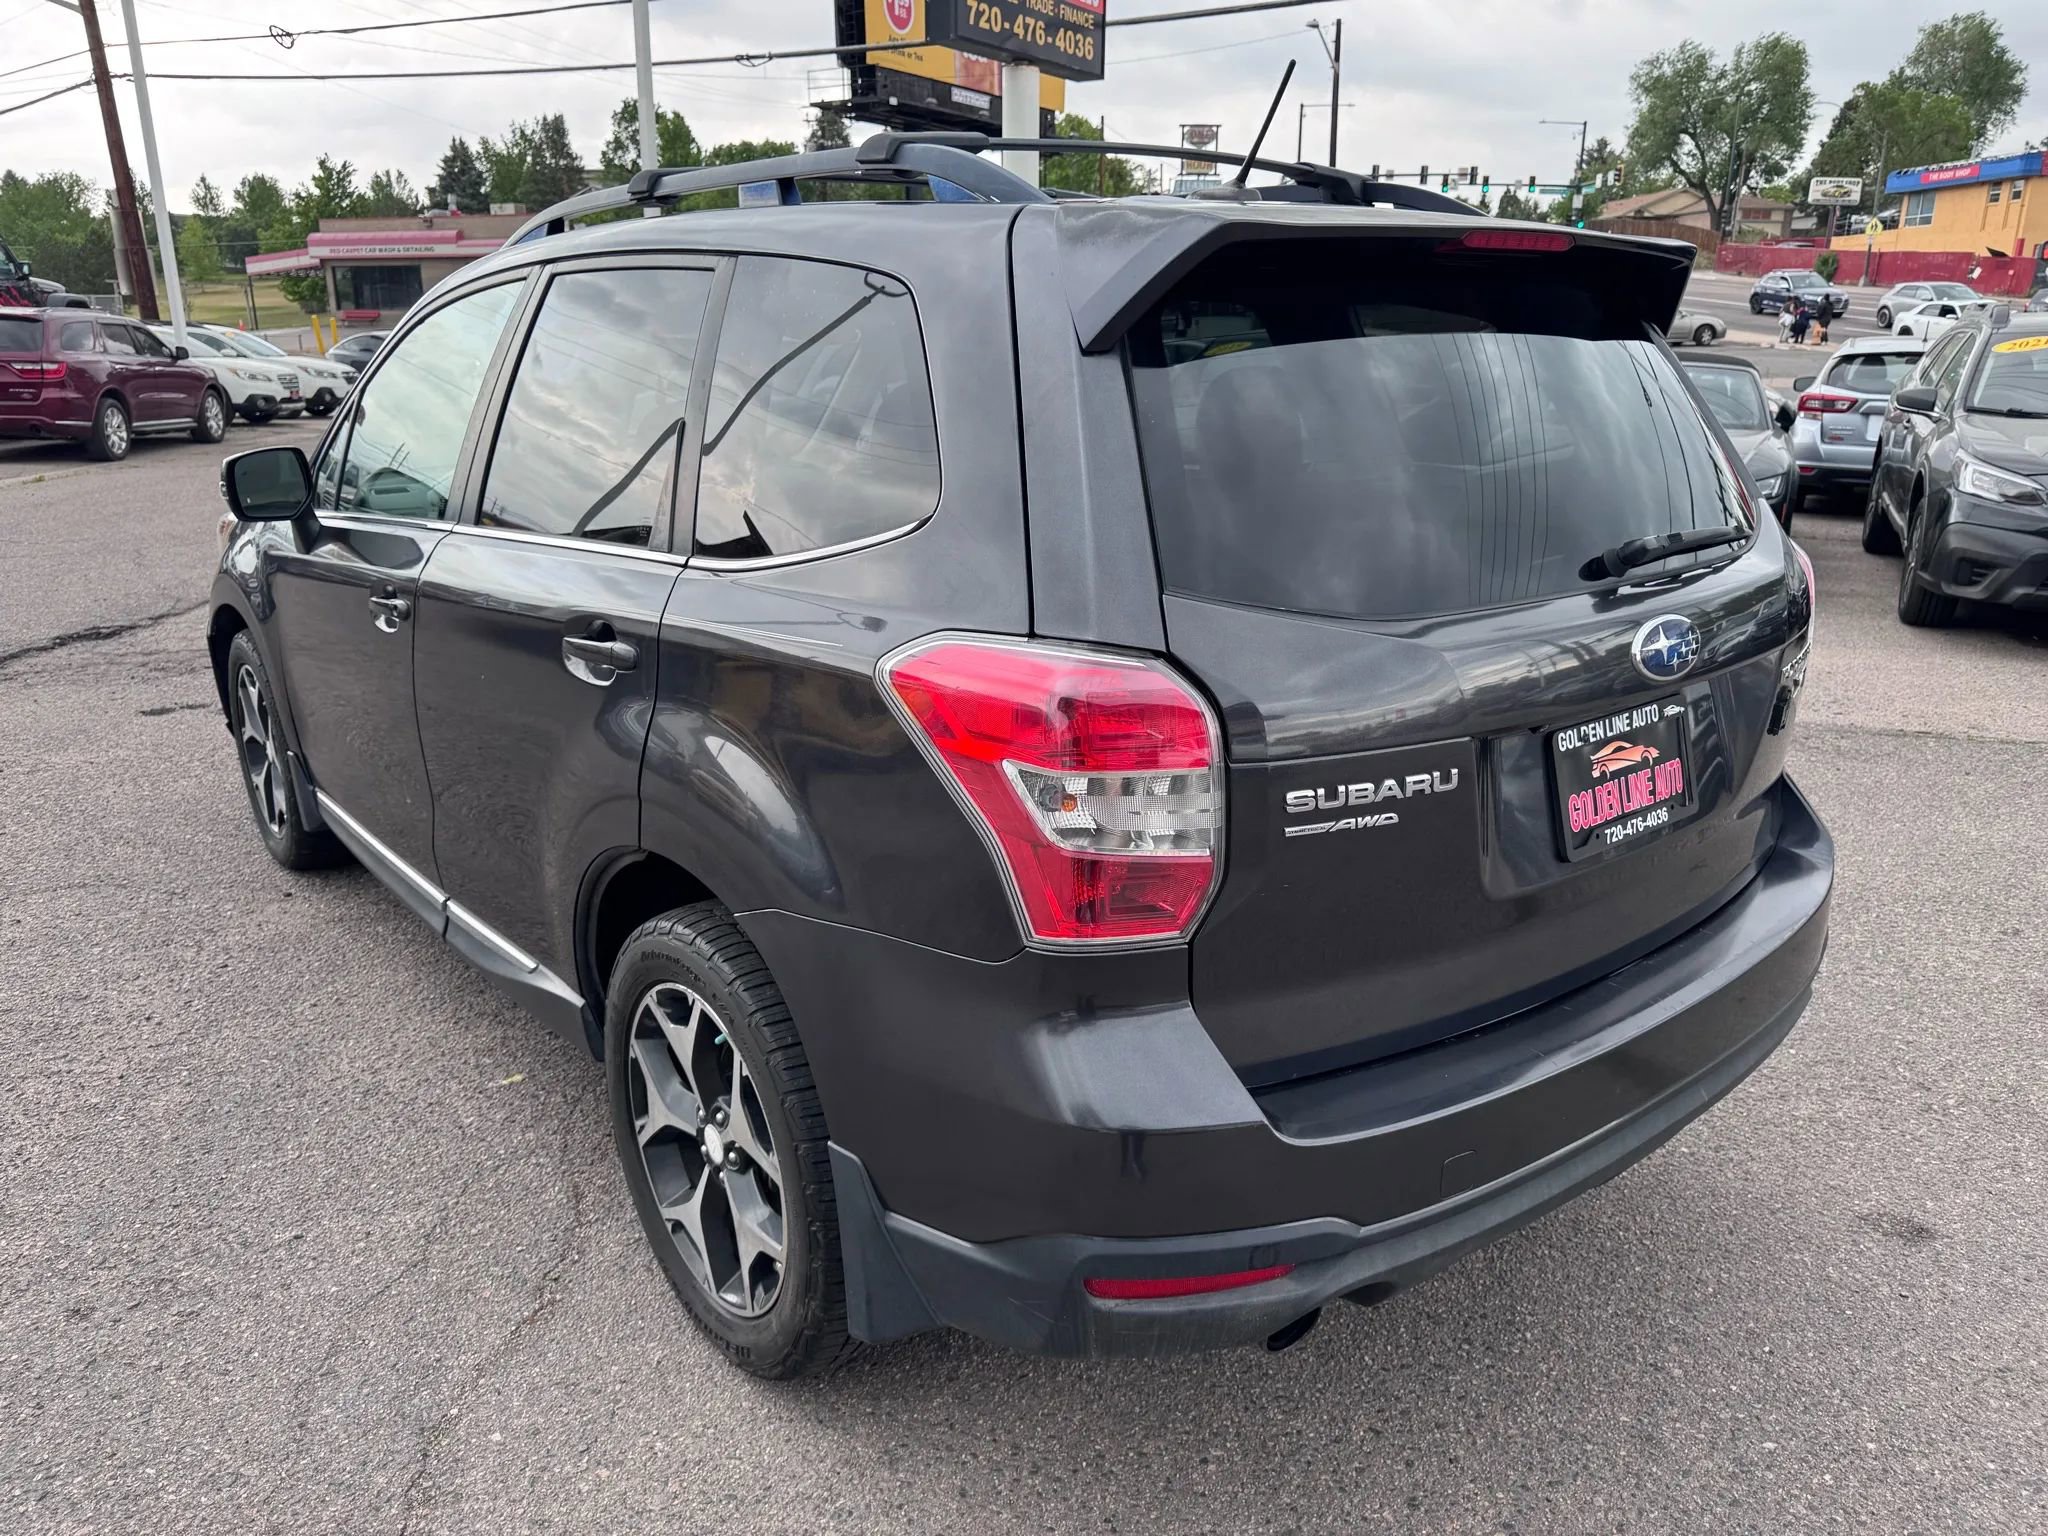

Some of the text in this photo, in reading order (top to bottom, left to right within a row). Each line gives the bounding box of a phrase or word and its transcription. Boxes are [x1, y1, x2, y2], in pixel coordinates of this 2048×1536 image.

[1059, 4, 1095, 29] FINANCE
[1606, 713, 1631, 737] LINE
[1632, 704, 1659, 728] AUTO
[1286, 768, 1459, 813] SUBARU
[1568, 758, 1684, 832] GOLDEN LINE AUTO
[1329, 813, 1399, 832] AWD
[1605, 807, 1668, 845] 720-476-4036
